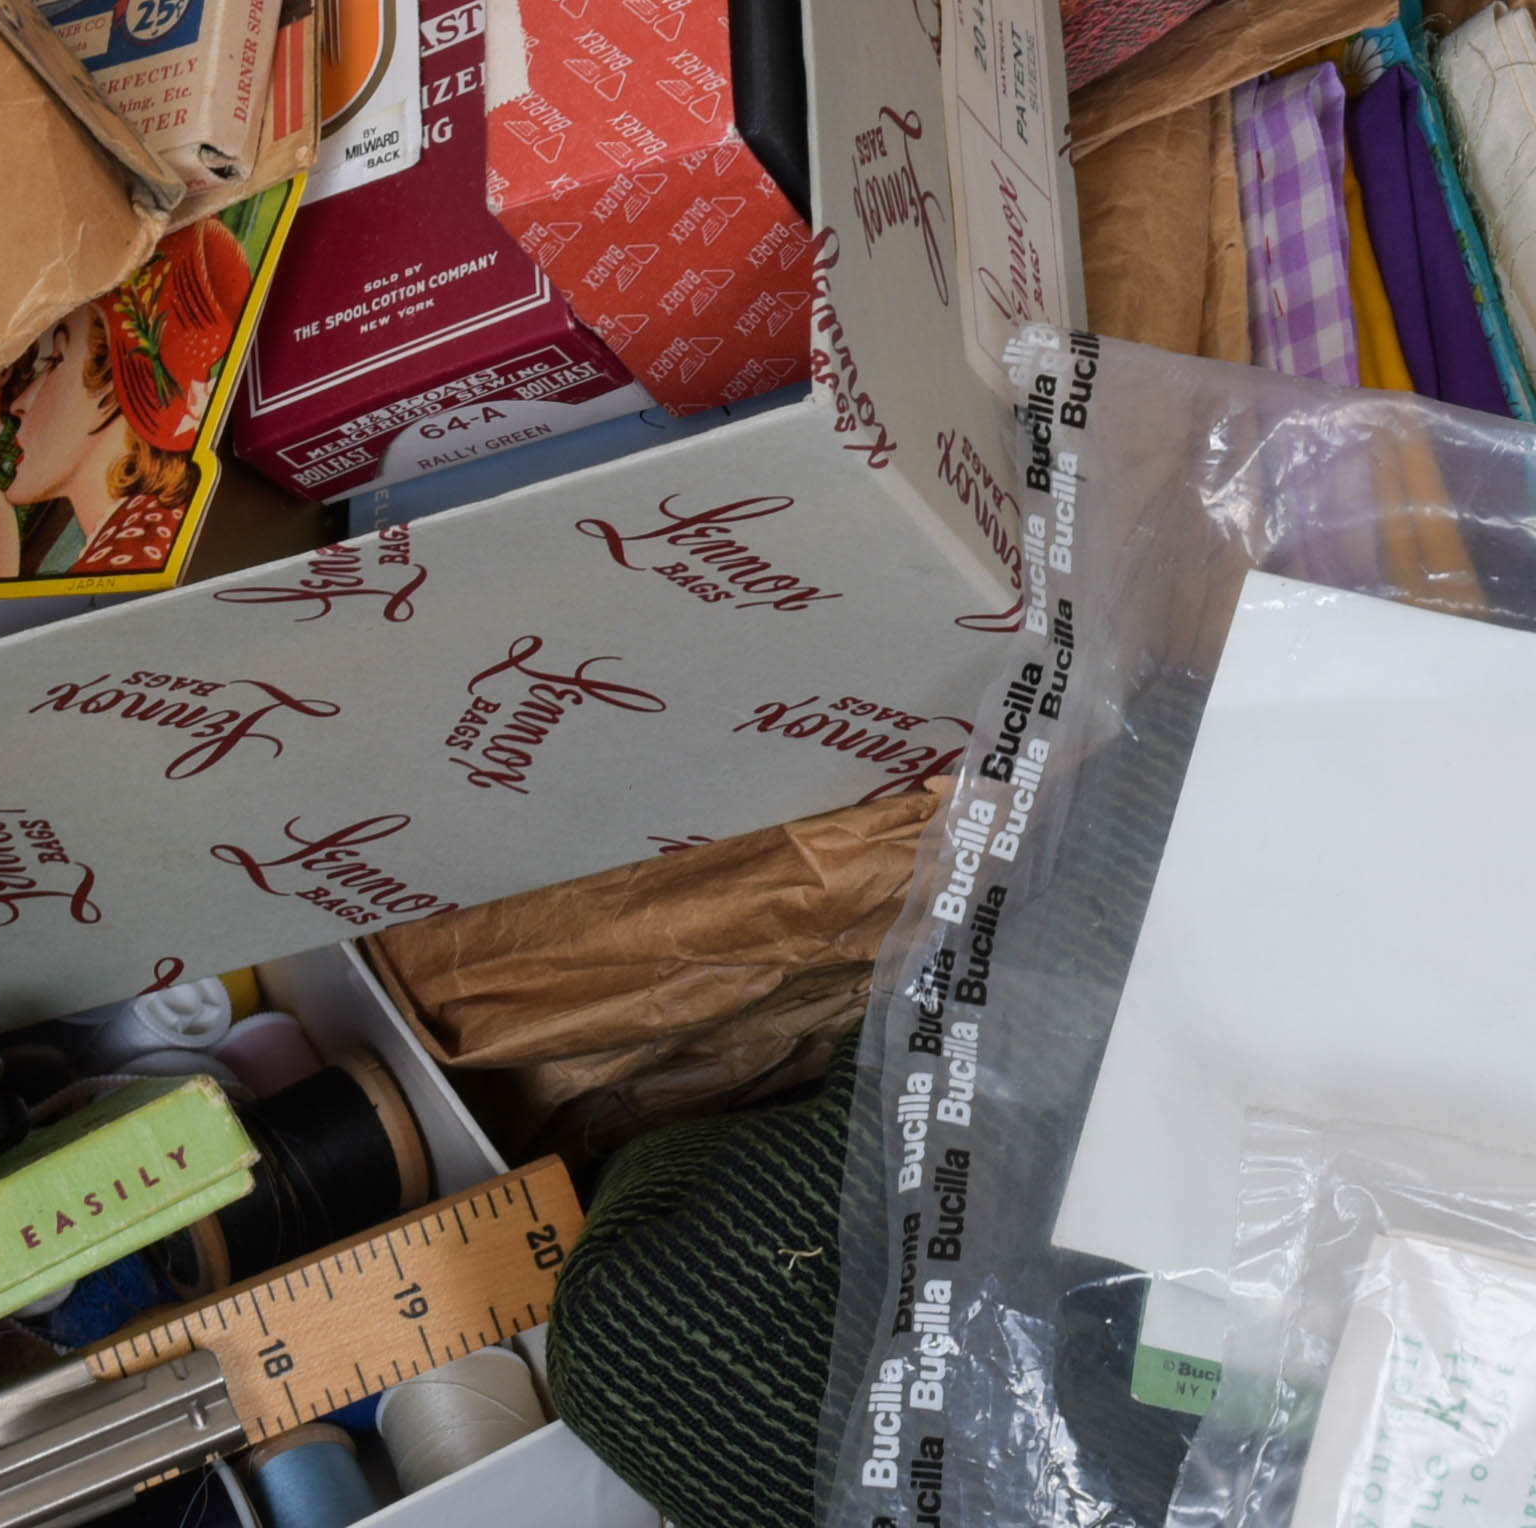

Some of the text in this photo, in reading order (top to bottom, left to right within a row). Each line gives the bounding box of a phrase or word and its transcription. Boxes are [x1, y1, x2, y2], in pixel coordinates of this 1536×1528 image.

[234, 35, 265, 123] DARNER
[574, 26, 634, 70] BALREX
[1024, 32, 1042, 115] SUEDE
[163, 84, 193, 105] Etc.
[1010, 21, 1031, 146] PATENT
[344, 130, 400, 163] MILWARD
[362, 127, 377, 139] BY
[366, 149, 402, 169] BACK
[855, 125, 888, 163] BAGS
[853, 104, 950, 307] Lennox
[292, 249, 499, 343] THE SPOOL COTTON COMPANY
[362, 263, 424, 293] SOLD BY
[1030, 241, 1045, 311] BAGS
[359, 297, 436, 335] NEW YORK
[305, 360, 551, 461] MERCERIZED SEWING
[516, 358, 602, 402] BOILFAST
[811, 348, 857, 433] BAGS
[417, 421, 554, 472] RALLY GREEN
[418, 403, 508, 442] 64-A
[292, 445, 376, 488] BOILFAST
[961, 434, 1006, 508] BAGS
[64, 576, 117, 594] JAPAN
[574, 492, 844, 612] Lennox
[652, 559, 737, 608] BAGS
[1024, 513, 1048, 636] Bucilla
[120, 670, 227, 699] BAGS
[1037, 599, 1075, 721] Bucilla
[28, 672, 342, 780] Lennox
[444, 690, 502, 753] BAGS
[467, 634, 668, 795] Lennox
[827, 694, 929, 733] BAGS
[981, 661, 1044, 785] Bucilla
[989, 737, 1052, 862] Bucilla
[16, 819, 71, 865] BAGS
[932, 797, 998, 925] Bucilla
[294, 885, 384, 929] BAGS
[954, 884, 1007, 1007] Bucilla
[898, 1071, 933, 1194] Bucilla
[20, 1145, 192, 1251] EASILY
[525, 1224, 565, 1271] 20
[392, 1281, 430, 1323] 19
[259, 1337, 294, 1383] 18
[908, 1279, 954, 1412] Bucilla
[862, 1358, 904, 1489] Bucilla
